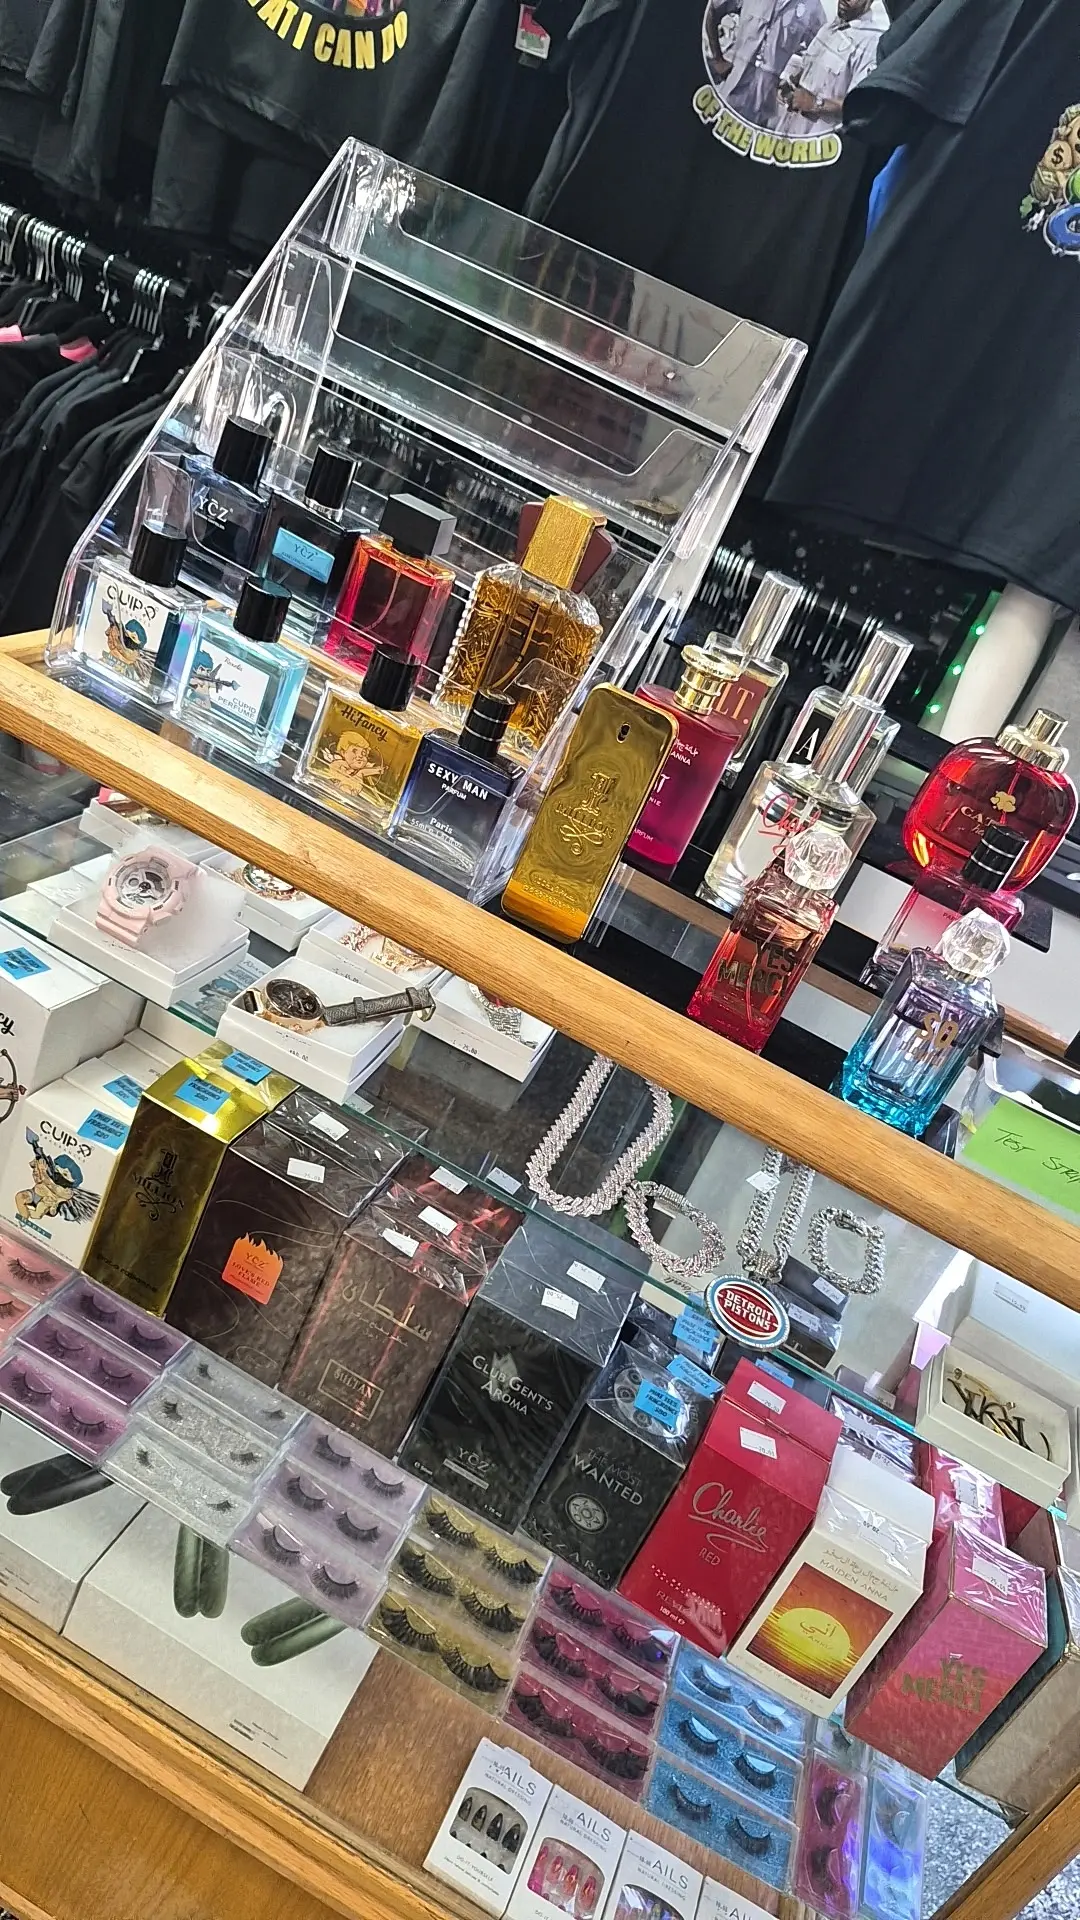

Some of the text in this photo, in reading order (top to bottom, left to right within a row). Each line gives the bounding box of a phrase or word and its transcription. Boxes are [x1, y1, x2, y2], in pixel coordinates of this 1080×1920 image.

[247, 0, 408, 70] AT I CAN DO
[694, 86, 839, 164] OF THE WORLD
[217, 695, 256, 720] PERFUME
[232, 697, 257, 714] CUPID
[714, 682, 755, 725] LT.
[671, 751, 691, 766] ANNA
[428, 762, 488, 800] SEXY MAN
[441, 783, 467, 800] PARFUM
[430, 817, 453, 834] Paris
[556, 800, 616, 839] MILLION
[756, 940, 798, 972] YES
[717, 958, 789, 998] MERCI
[916, 1012, 959, 1050] SO
[1042, 1156, 1080, 1184] STRI
[132, 1171, 185, 1209] MILLION
[238, 1271, 260, 1288] FLAME
[256, 1274, 270, 1287] RED
[723, 1298, 772, 1331] PISTONS
[725, 1289, 774, 1320] DETROIT
[333, 1368, 375, 1400] SULTAN
[472, 1355, 555, 1411] CLUB GENT'S
[481, 1380, 529, 1416] AROMA
[574, 1454, 643, 1506] WANTED
[588, 1448, 608, 1466] THE
[608, 1463, 642, 1487] MOST
[692, 1482, 769, 1549] Charlie
[699, 1547, 721, 1566] RED
[819, 1559, 888, 1602] MAIDEN ANNA
[940, 1658, 987, 1689] YES
[490, 1765, 537, 1796] AILS
[577, 1812, 612, 1842] AILS
[652, 1860, 689, 1890] AILS
